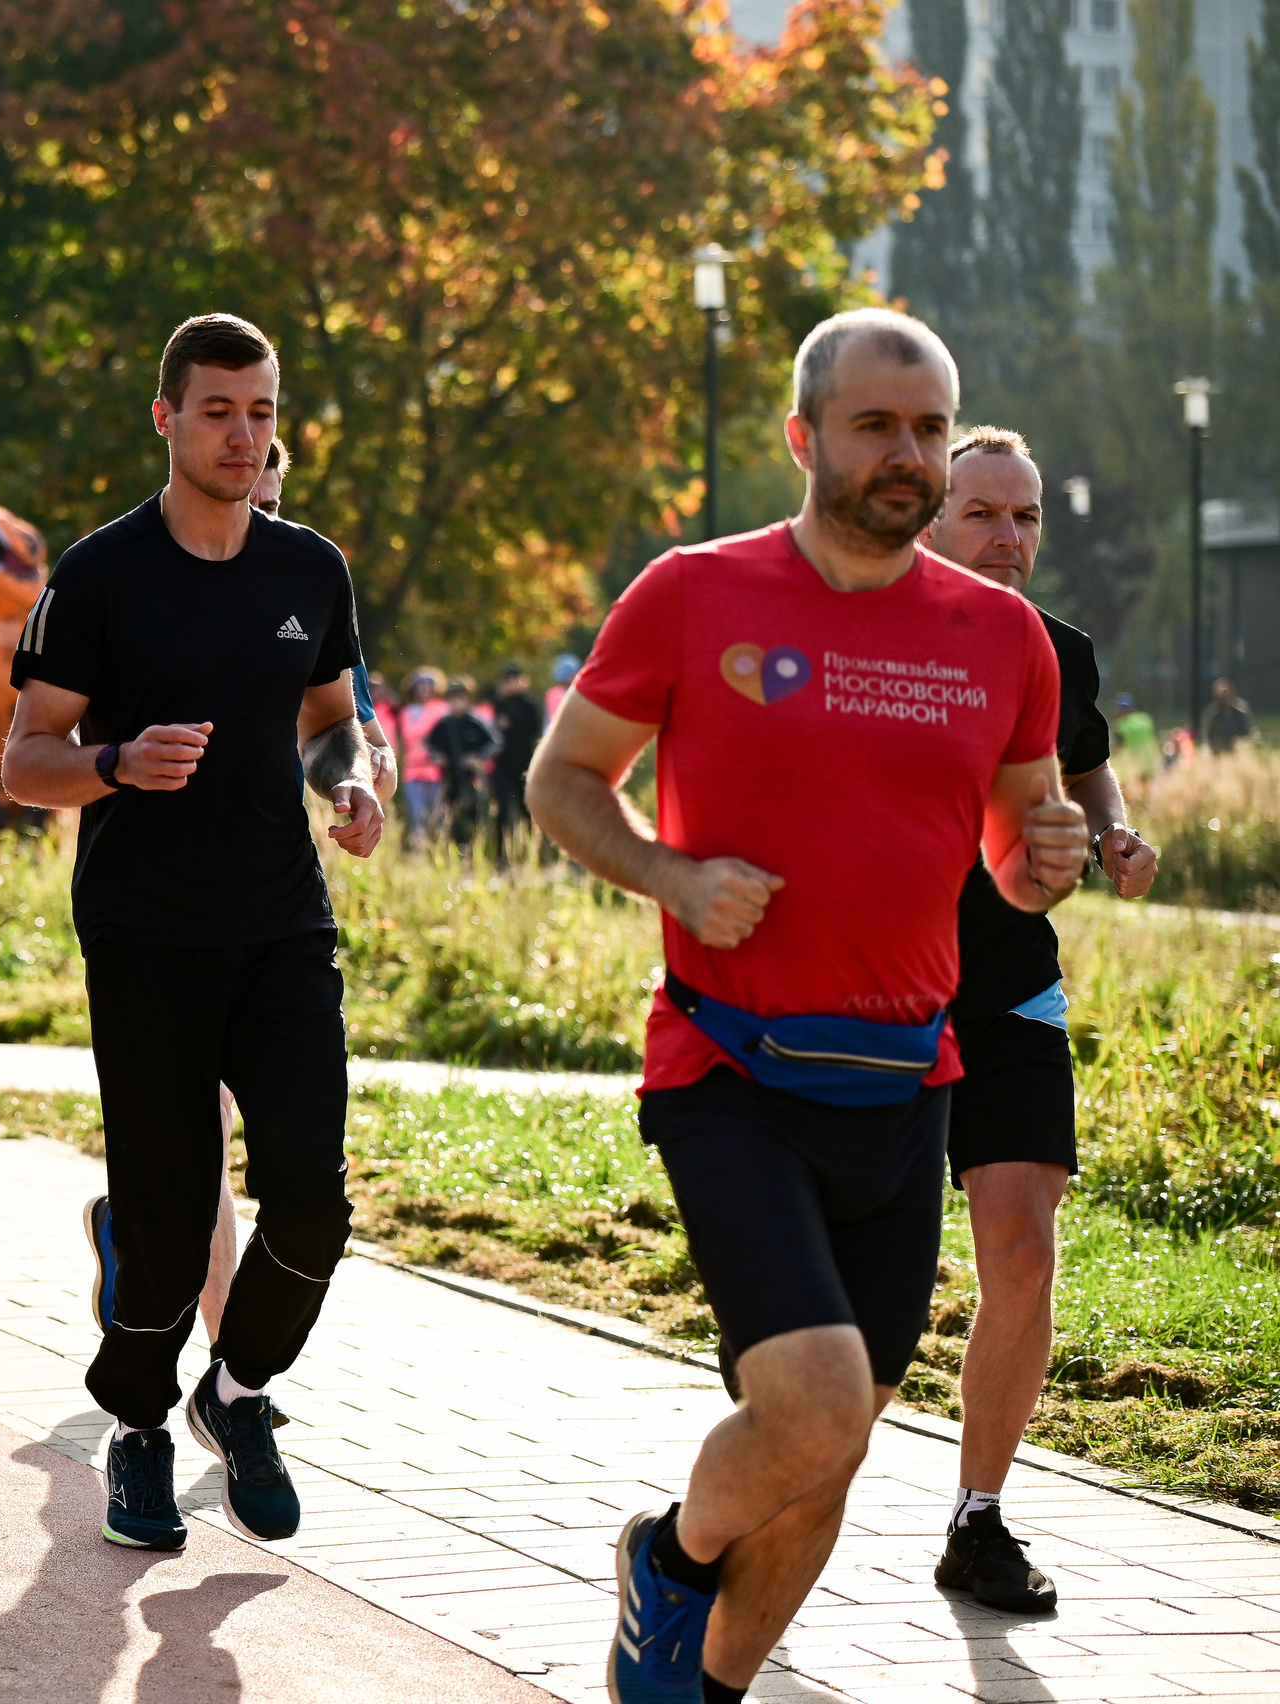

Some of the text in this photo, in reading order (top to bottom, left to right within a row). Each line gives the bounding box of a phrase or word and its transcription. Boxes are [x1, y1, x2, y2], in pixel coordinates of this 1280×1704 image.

[276, 629, 309, 641] adidas
[823, 651, 969, 683] Промсвязьбанк
[824, 671, 988, 710] МОСКОВСКИЙ
[825, 693, 949, 726] МАРАФОН
